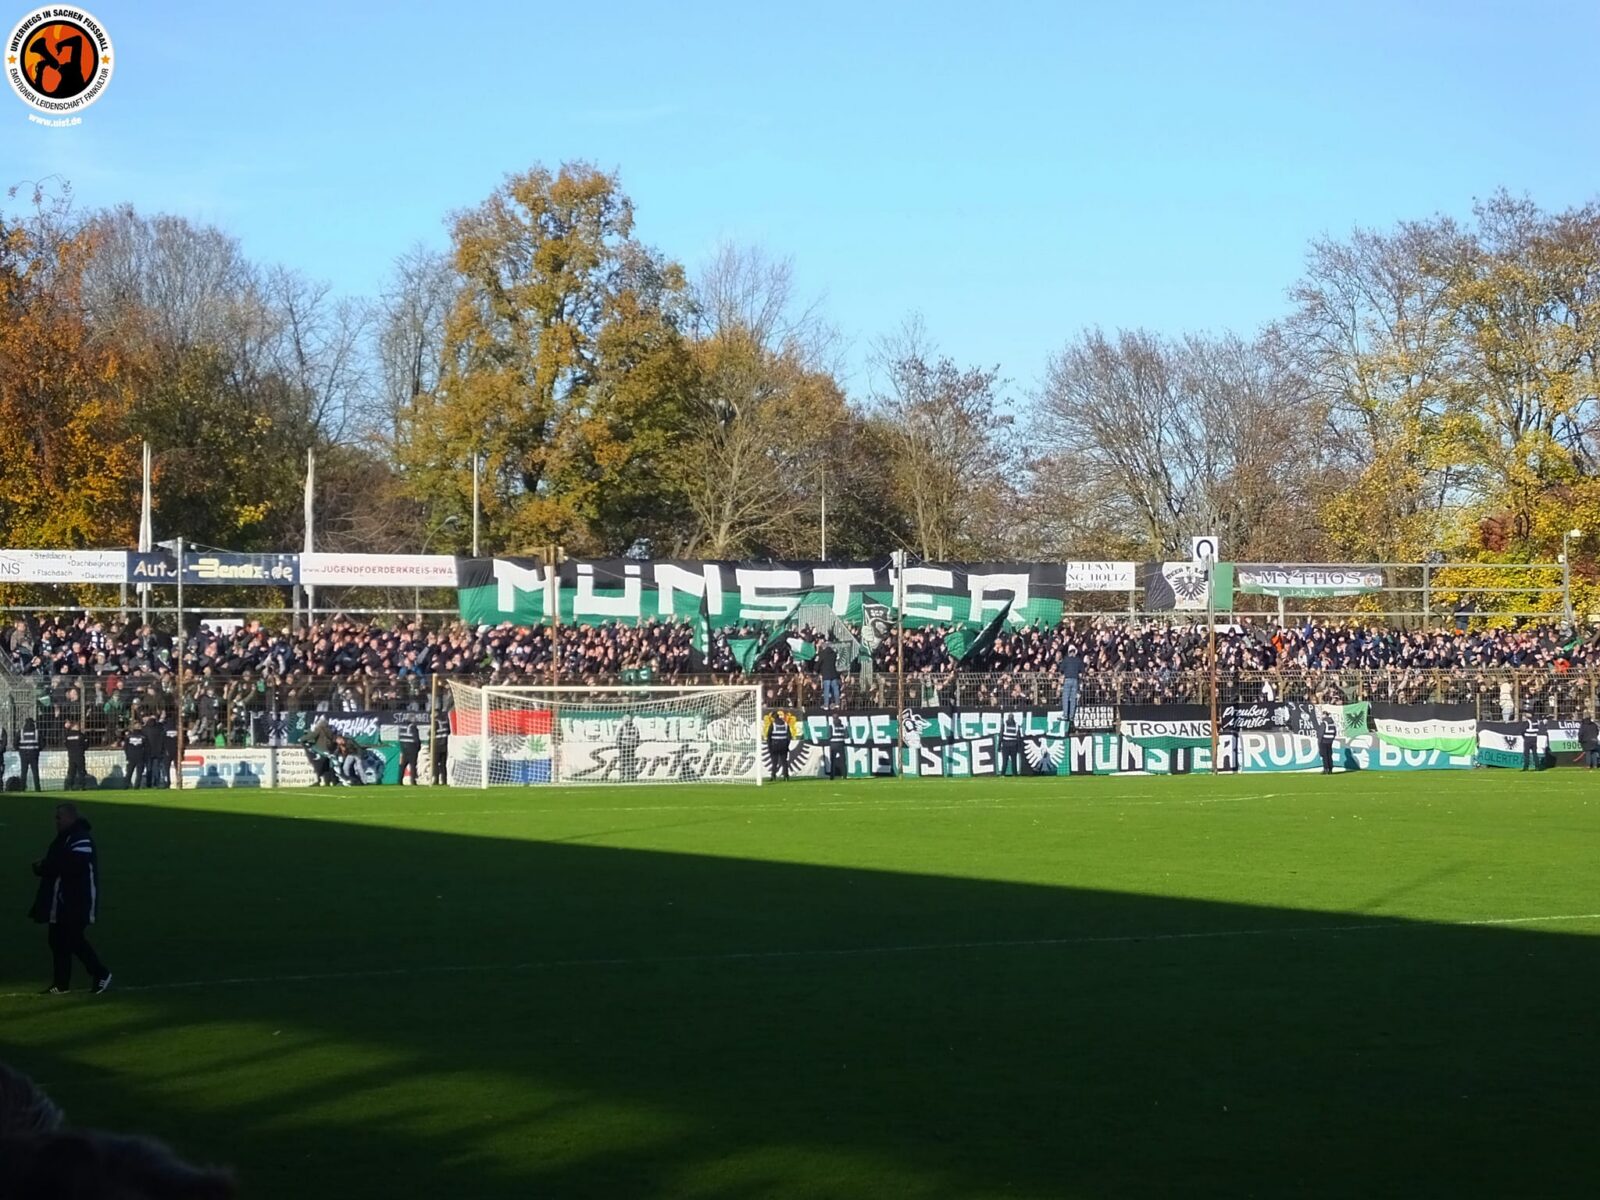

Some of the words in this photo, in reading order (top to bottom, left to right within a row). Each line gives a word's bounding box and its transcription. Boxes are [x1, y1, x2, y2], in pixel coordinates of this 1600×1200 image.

[1260, 570, 1361, 585] MYTHOS
[493, 557, 1030, 623] MÜNSTER
[1129, 722, 1212, 738] TROJANS
[1559, 721, 1581, 729] Linie
[1479, 751, 1524, 766] ADLERTR
